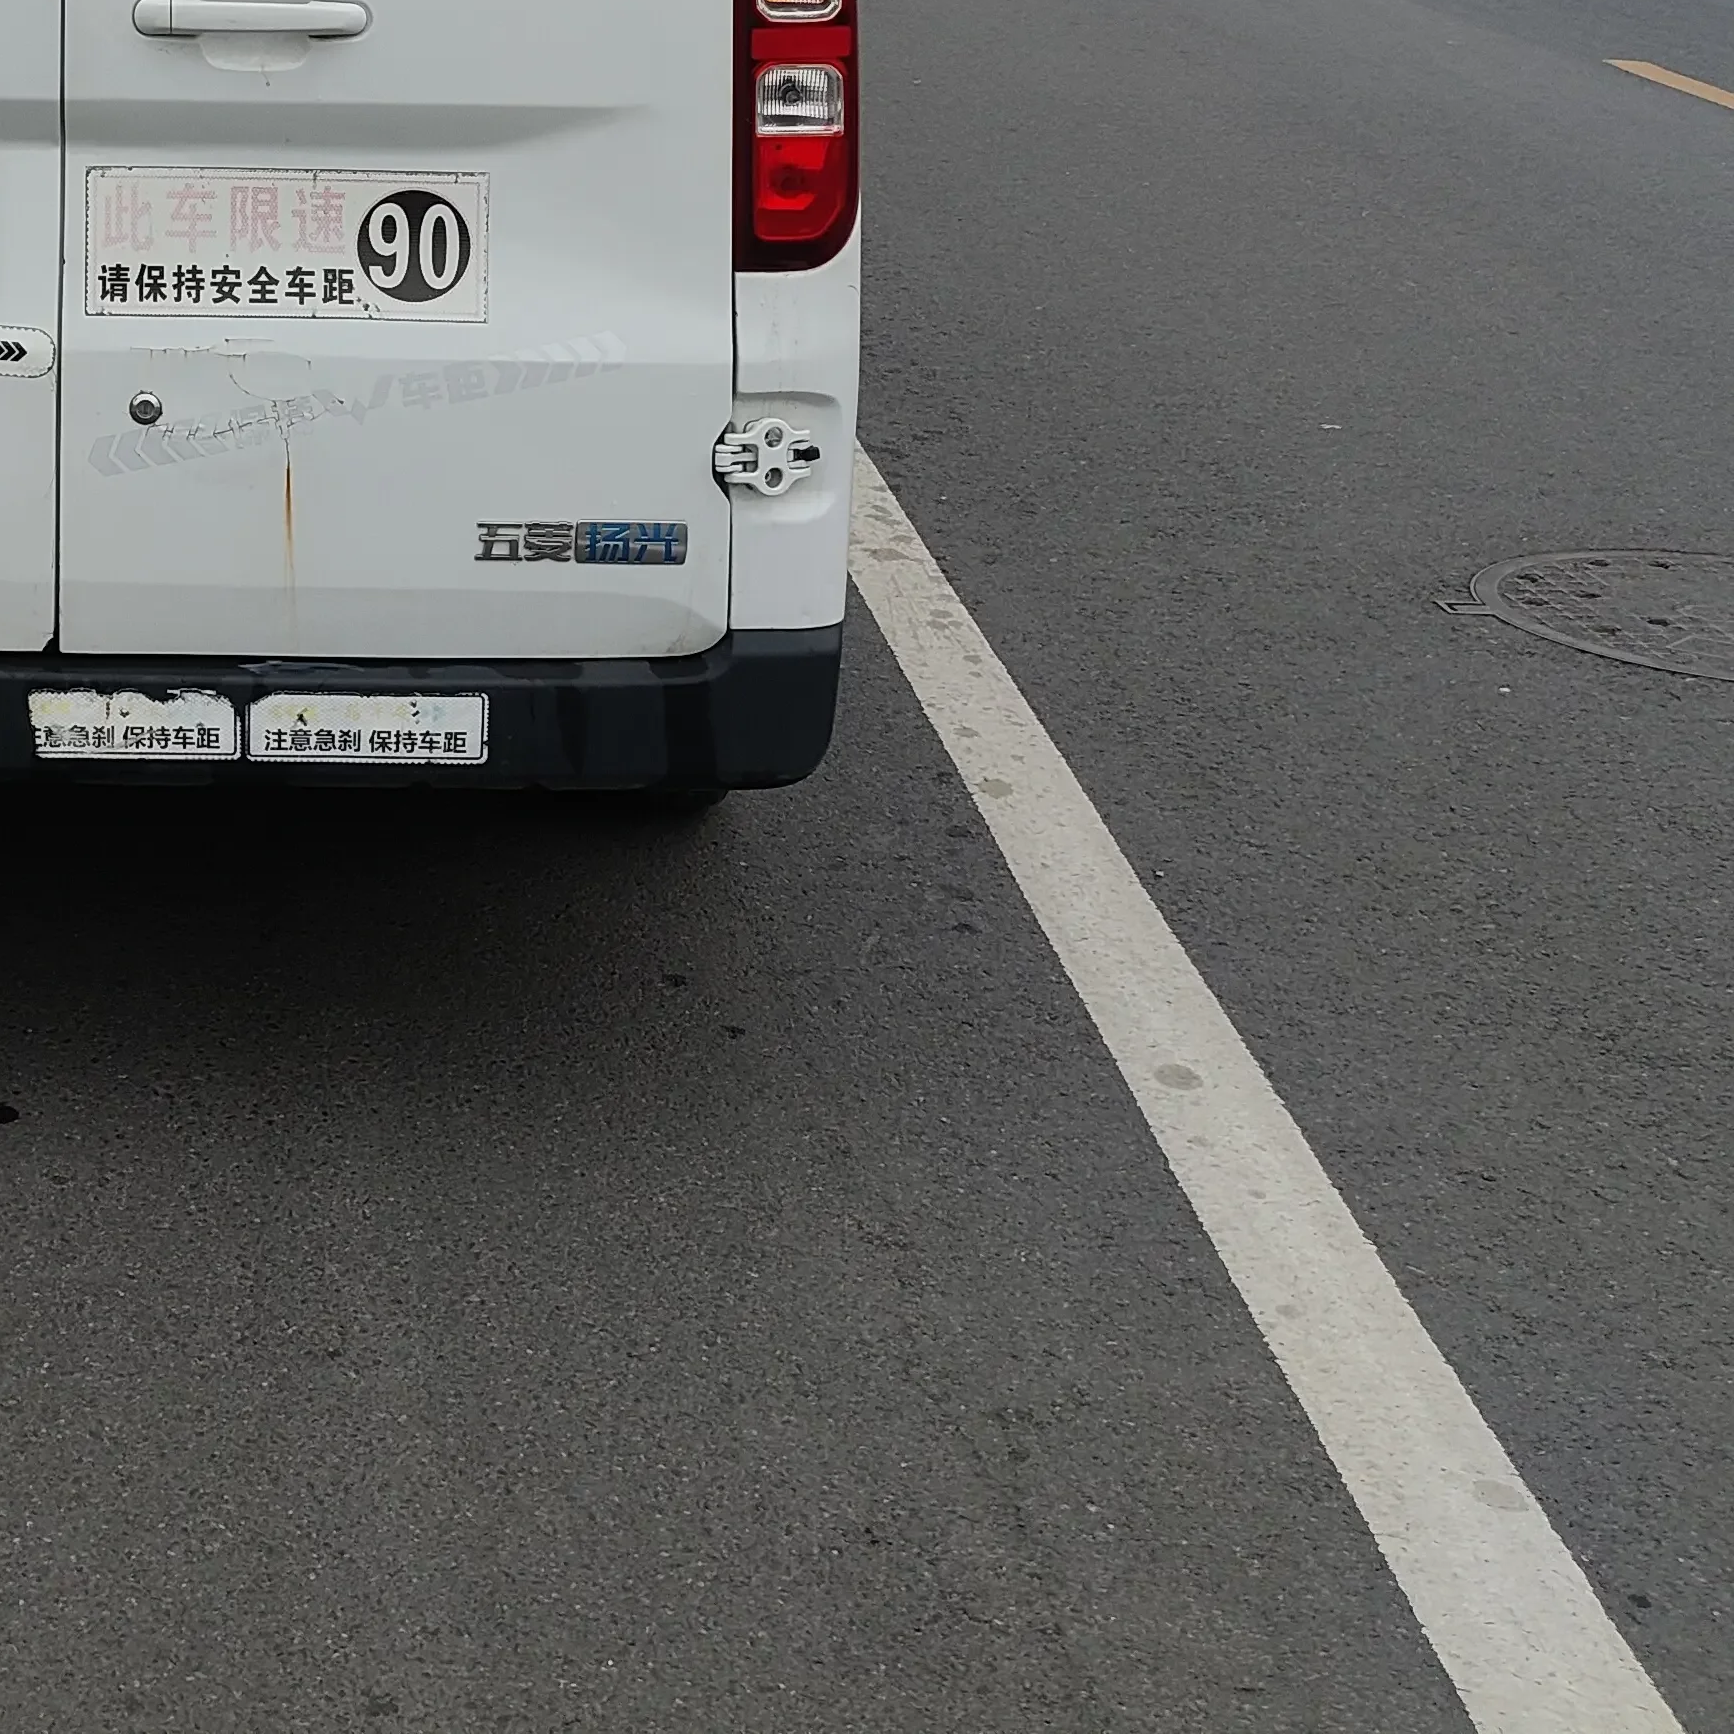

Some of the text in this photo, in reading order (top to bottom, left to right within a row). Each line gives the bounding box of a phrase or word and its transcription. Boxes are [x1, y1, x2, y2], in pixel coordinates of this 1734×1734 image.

[102, 183, 347, 255] 此车限速
[368, 202, 461, 290] 90
[97, 263, 355, 306] 请保持安全车距
[123, 726, 221, 749] 保持车距
[265, 728, 468, 754] 注意急刹 保持车距
